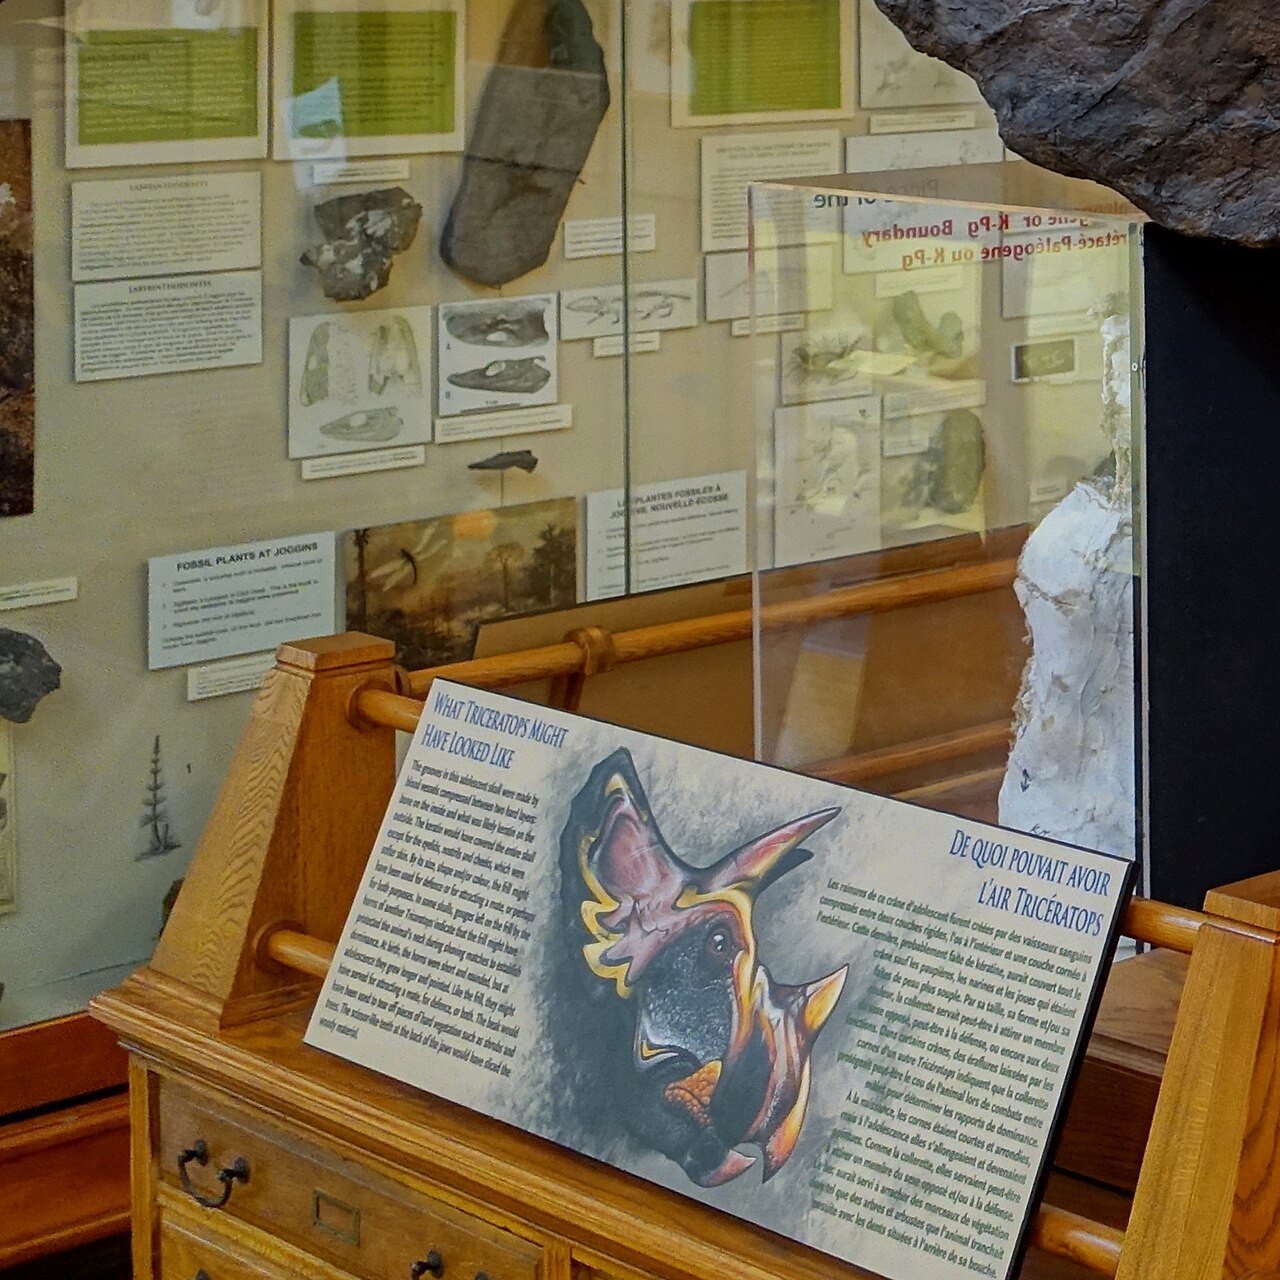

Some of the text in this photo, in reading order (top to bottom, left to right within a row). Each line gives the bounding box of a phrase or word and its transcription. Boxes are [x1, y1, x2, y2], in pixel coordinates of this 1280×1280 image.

[176, 542, 318, 572] FOSSIL PLANTS AT JOGGINS
[420, 723, 516, 769] HAVE LOOKED LIKE
[434, 691, 569, 749] WHAT TRICERATOPS MIGHT
[949, 829, 1111, 896] DE QUOI POUVAIT AVOIR
[978, 878, 1104, 936] L'AIR TRICÉRATOPS
